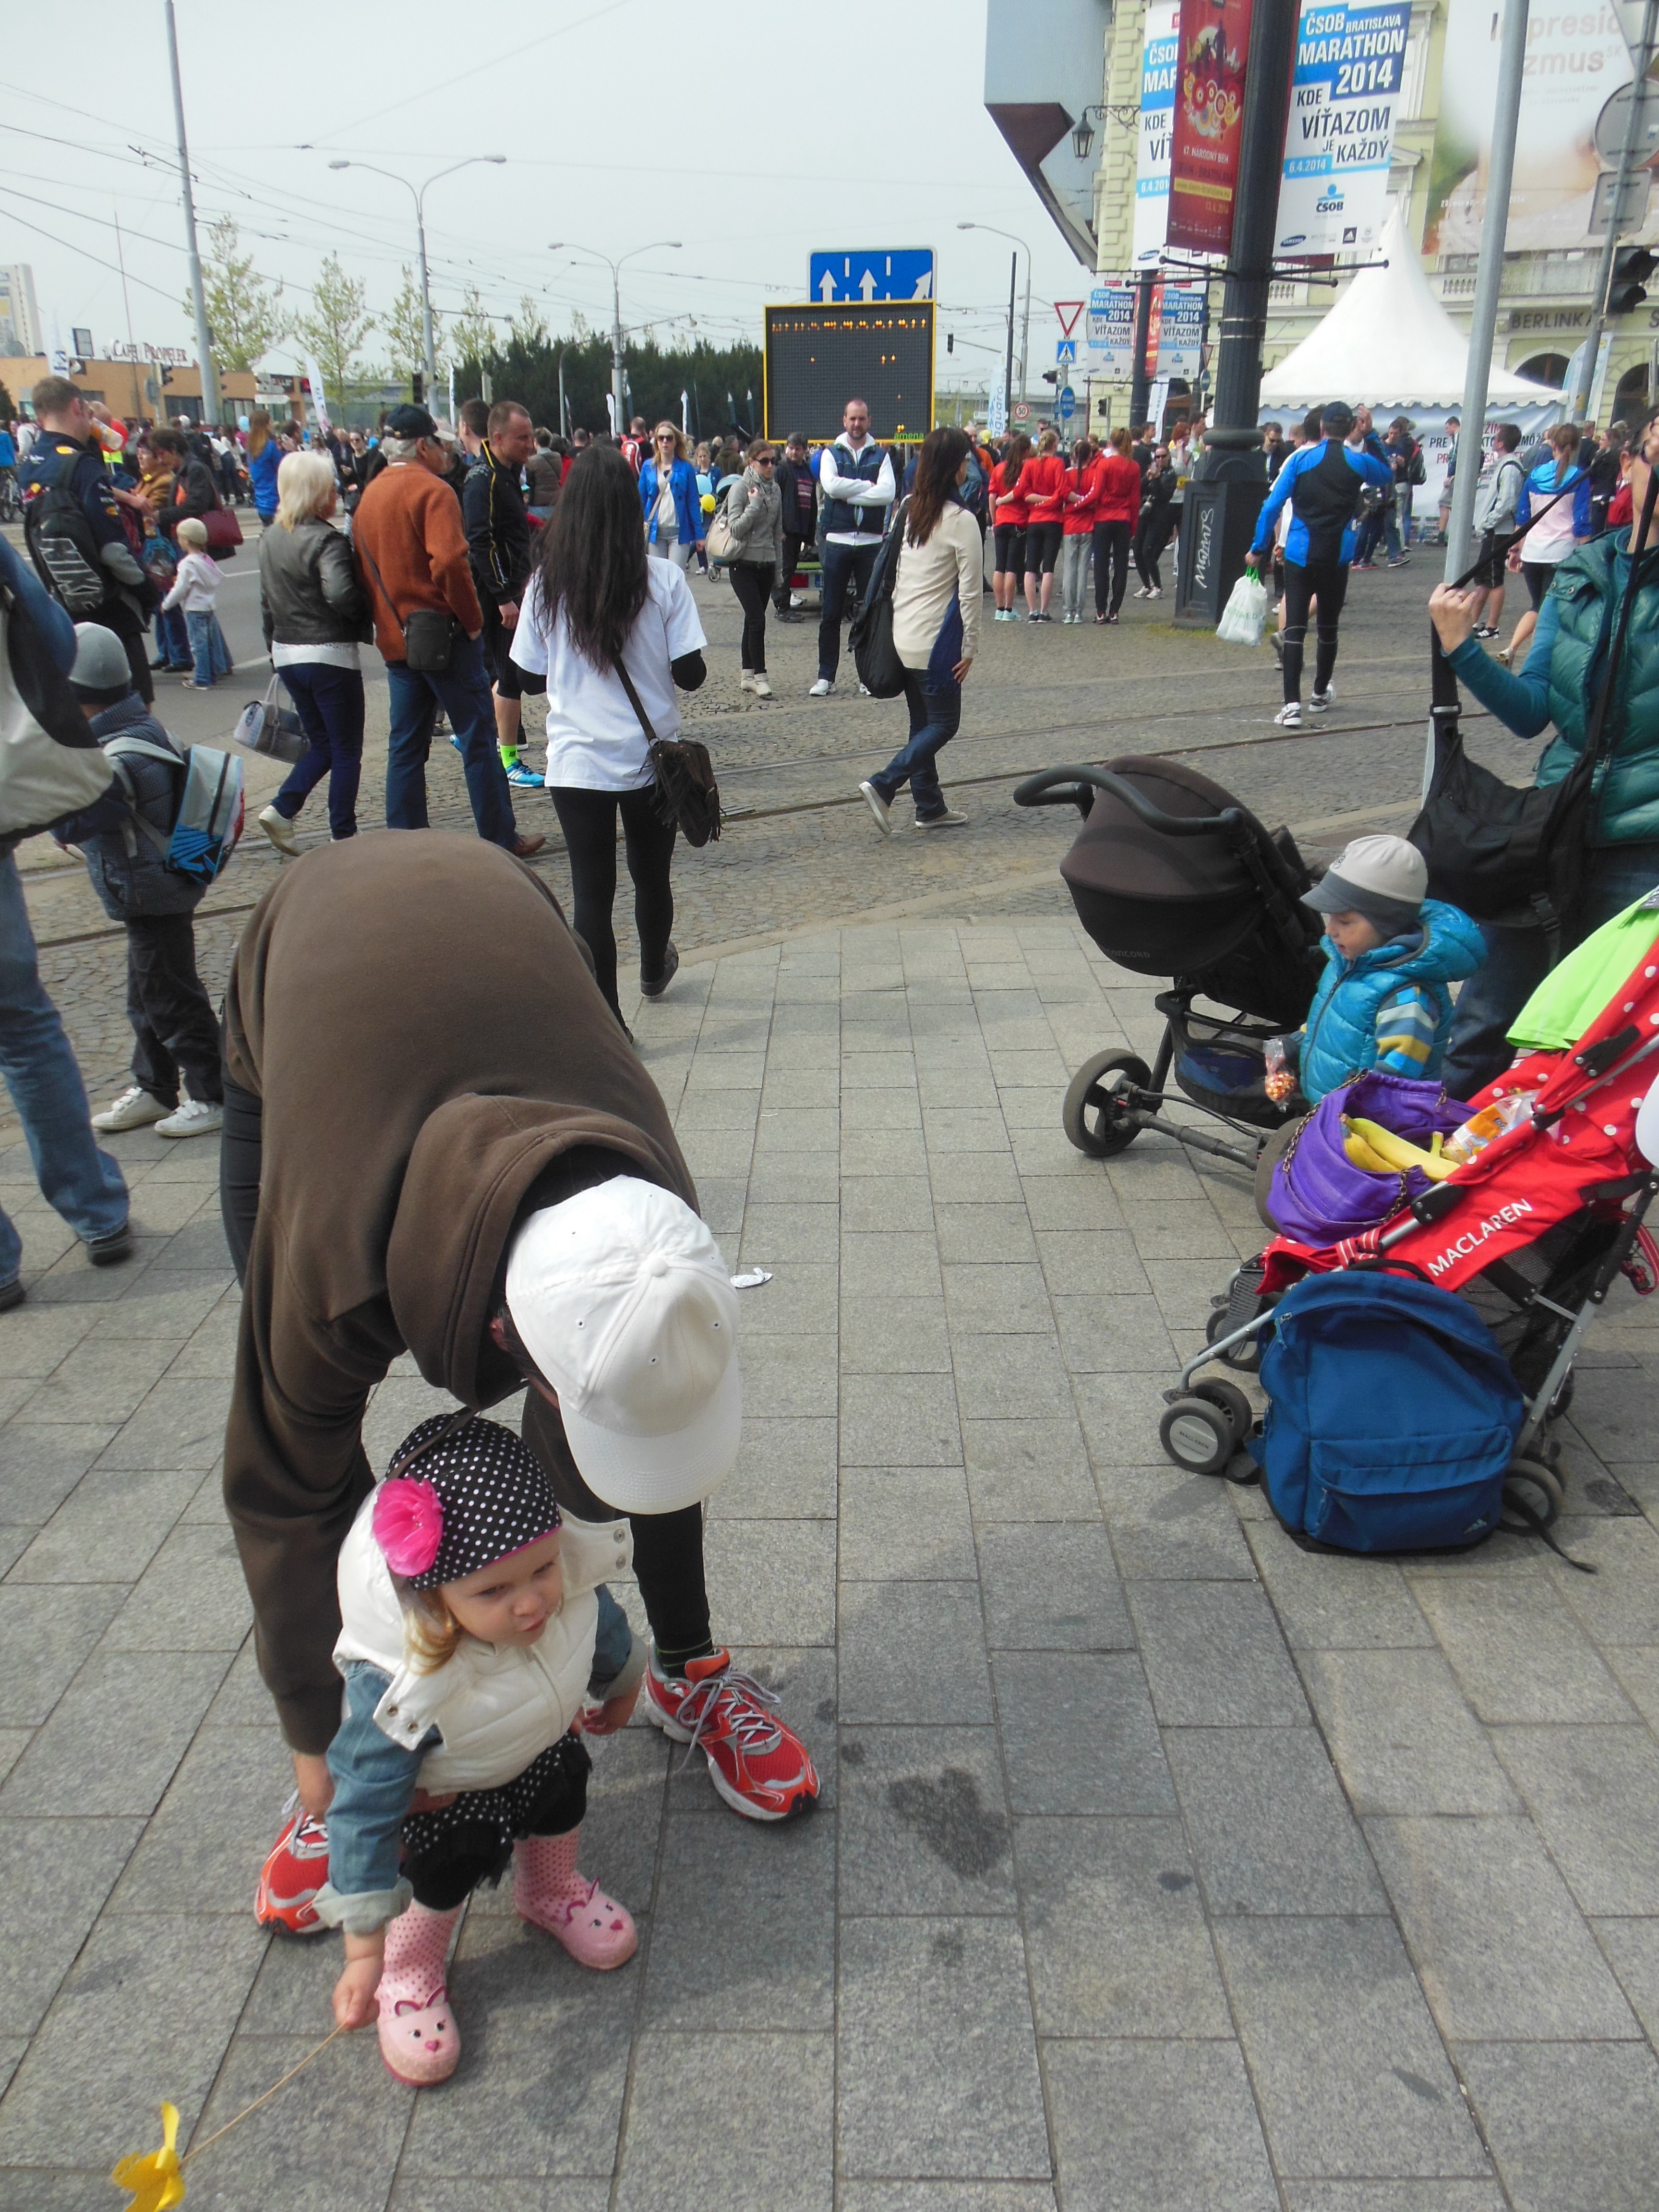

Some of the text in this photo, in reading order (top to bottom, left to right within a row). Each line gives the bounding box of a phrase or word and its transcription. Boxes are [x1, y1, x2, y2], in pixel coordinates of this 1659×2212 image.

[1306, 12, 1401, 36] ČSOB BRATISLAVA
[1298, 29, 1405, 66] MARATHON
[1336, 58, 1393, 94] 2014
[1297, 89, 1323, 107] KDE
[1144, 113, 1166, 132] KDE
[1302, 107, 1391, 140] VÍŤAZOM
[1323, 139, 1334, 152] JE
[1336, 134, 1389, 163] KAŽDÝ
[1289, 159, 1326, 173] 6.4.2014
[1316, 200, 1344, 213] ČSOB
[1092, 300, 1133, 309] MARATHON
[1108, 310, 1130, 321] 2014
[1177, 312, 1200, 322] 2014
[1095, 325, 1130, 336] VÍŤAZOM
[1429, 437, 1448, 448] PRE
[1427, 1198, 1534, 1277] MACLAREN
